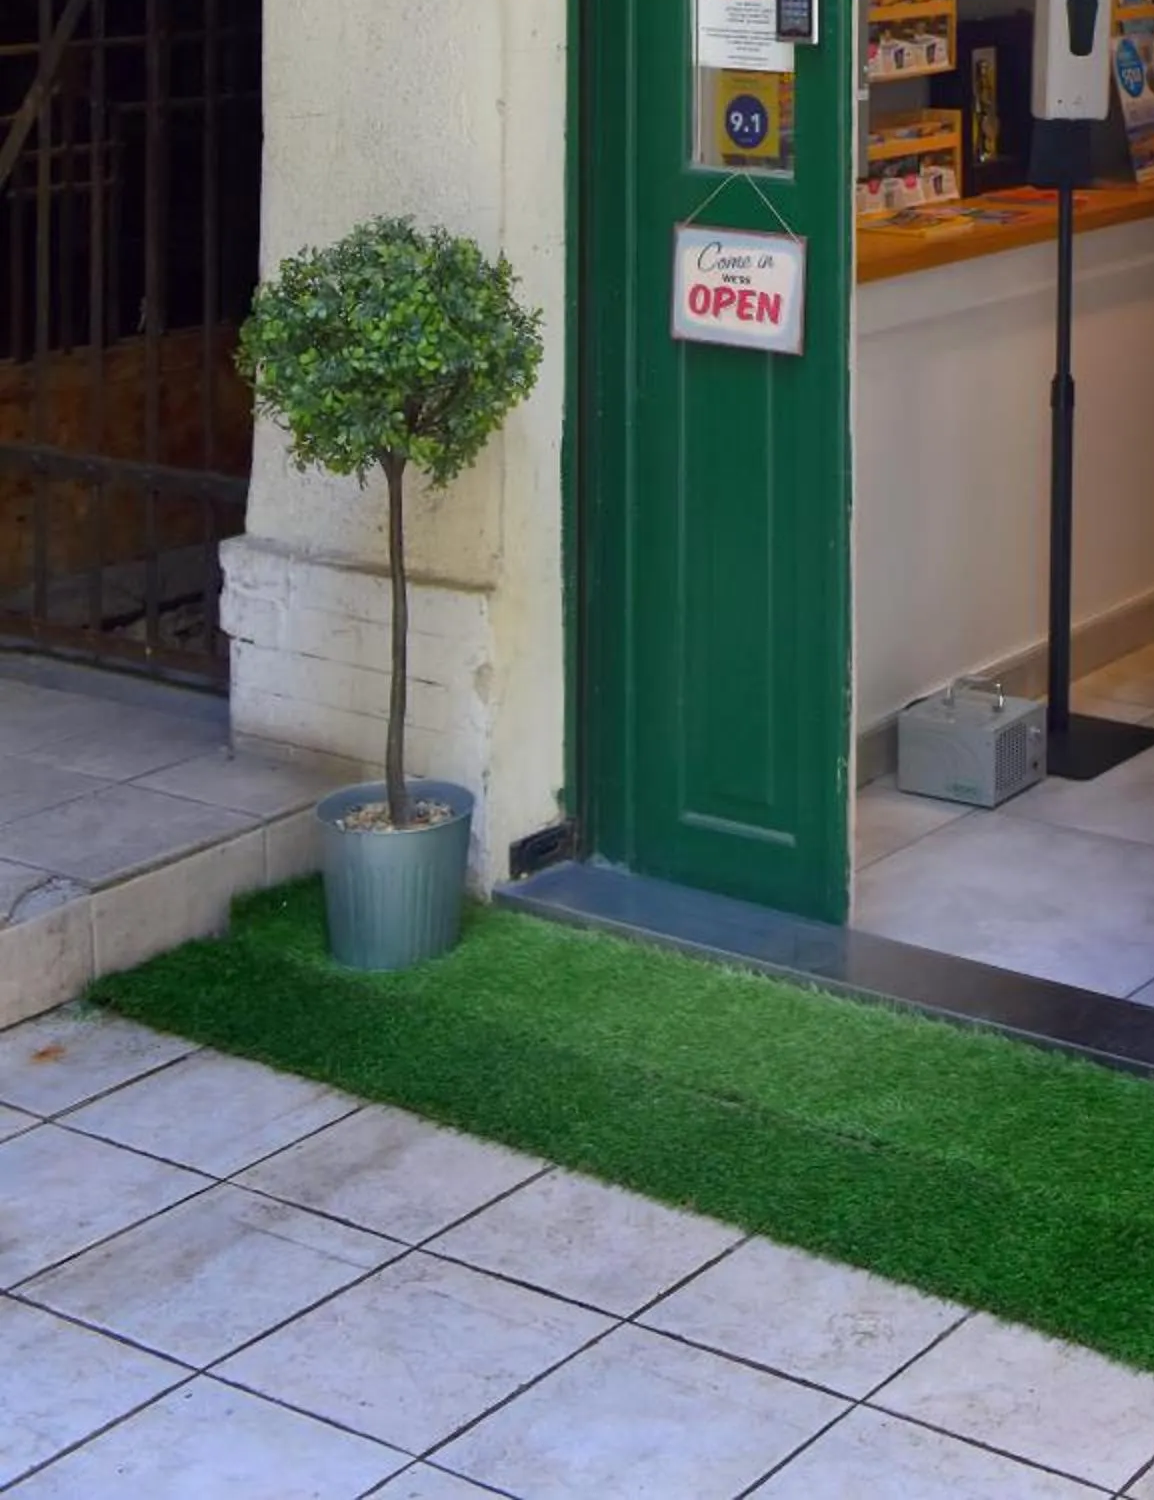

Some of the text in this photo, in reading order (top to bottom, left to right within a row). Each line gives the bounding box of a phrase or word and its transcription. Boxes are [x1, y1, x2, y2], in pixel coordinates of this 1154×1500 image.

[730, 110, 760, 133] 9.1
[697, 241, 775, 273] Come in
[688, 283, 783, 325] OPEN
